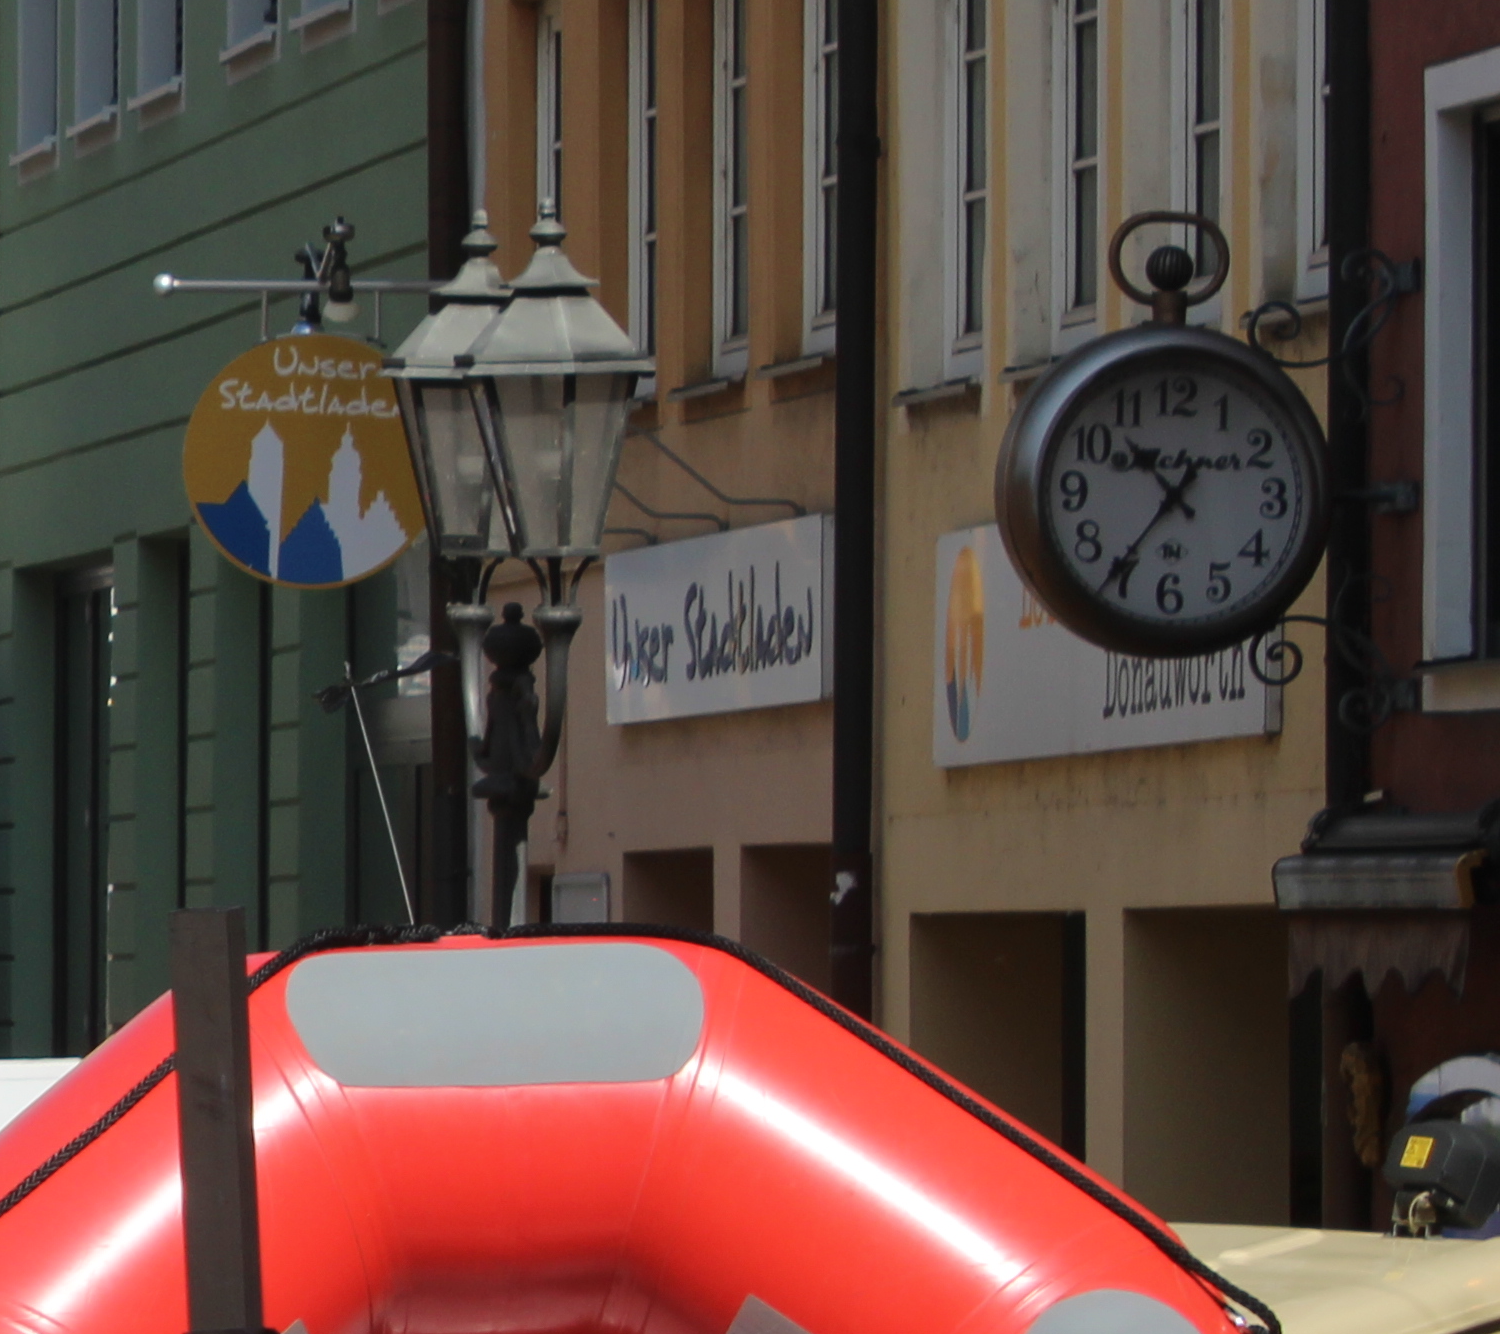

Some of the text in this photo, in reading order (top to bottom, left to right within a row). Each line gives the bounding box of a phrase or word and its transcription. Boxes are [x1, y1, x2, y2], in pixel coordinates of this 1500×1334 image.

[273, 345, 376, 380] Unser
[1113, 388, 1142, 427] 11
[1154, 376, 1198, 417] 12
[1214, 393, 1229, 431] 1
[1071, 423, 1112, 464] 10
[1247, 428, 1274, 469] 2
[1060, 470, 1088, 512] 9
[1260, 477, 1288, 519] 3
[1074, 520, 1102, 563] 8
[1237, 528, 1270, 567] 4
[1114, 559, 1140, 599] 7
[1155, 573, 1184, 614] 6
[1206, 561, 1232, 603] 5
